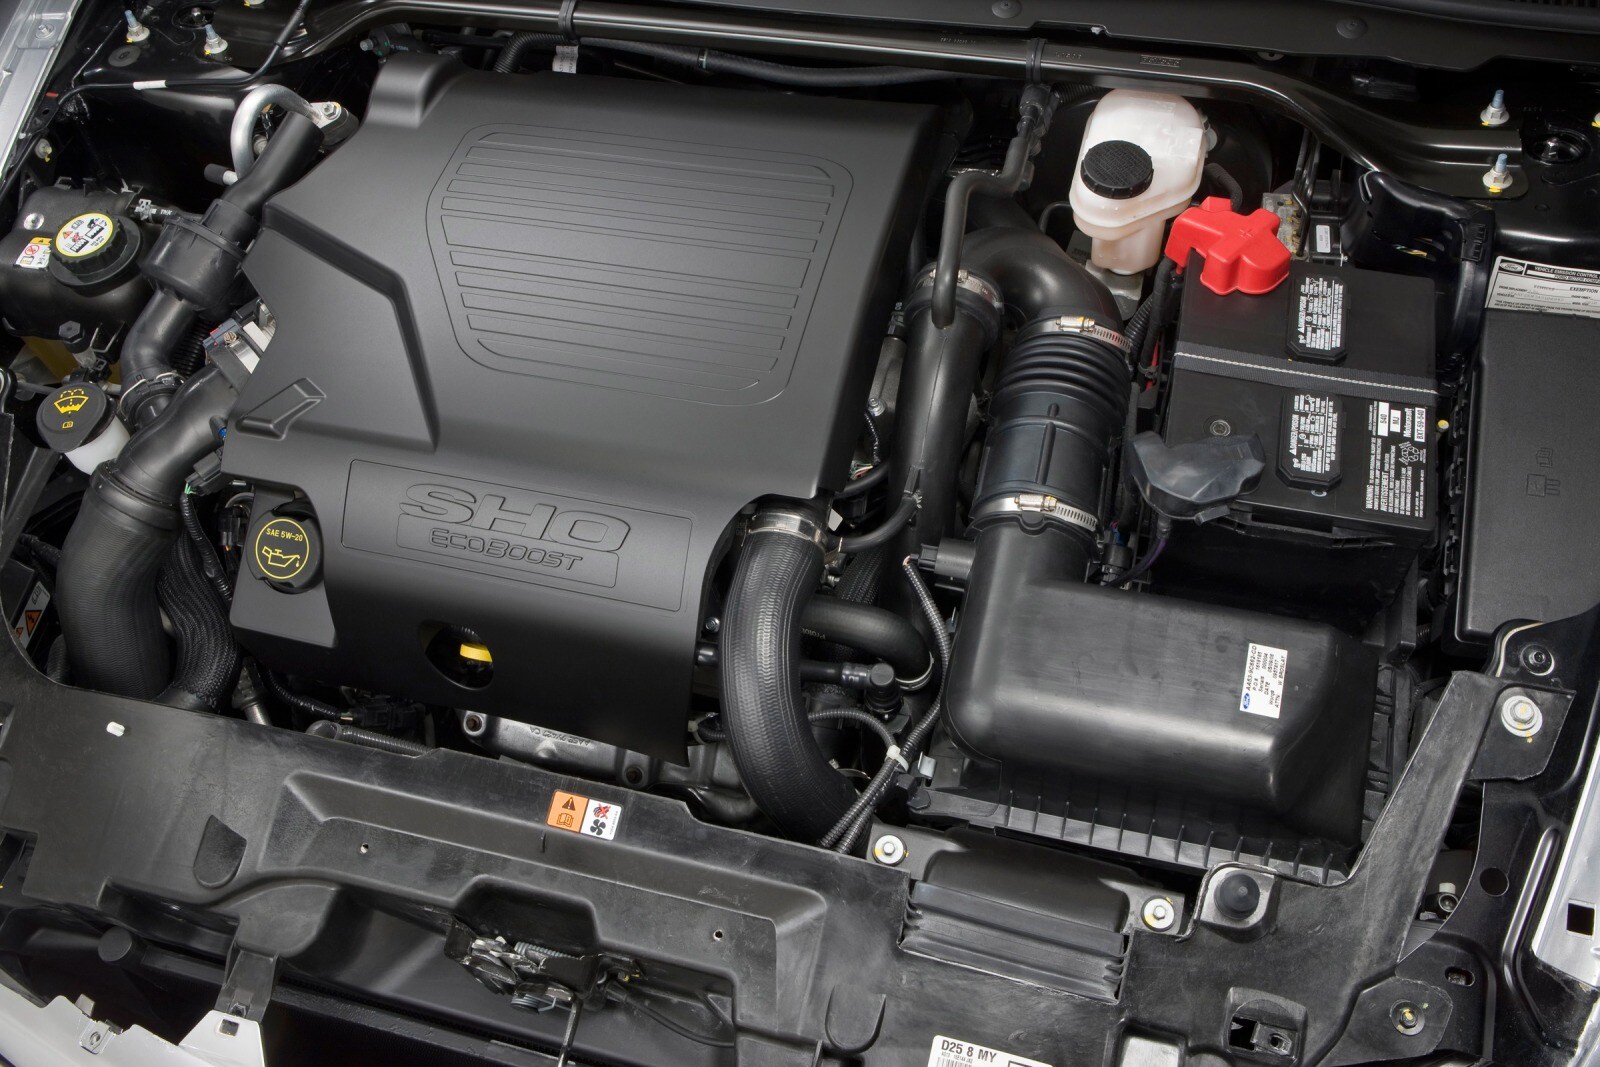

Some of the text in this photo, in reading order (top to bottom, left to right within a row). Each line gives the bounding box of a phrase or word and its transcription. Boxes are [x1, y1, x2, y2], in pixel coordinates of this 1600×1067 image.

[1403, 408, 1414, 438] Motorcraft
[1380, 472, 1389, 512] AVERTISSEMENT
[399, 483, 631, 552] SHO
[266, 528, 303, 542] SAE 5W-20
[941, 1039, 964, 1055] D25
[966, 1046, 974, 1057] 8
[978, 1048, 997, 1063] MY
